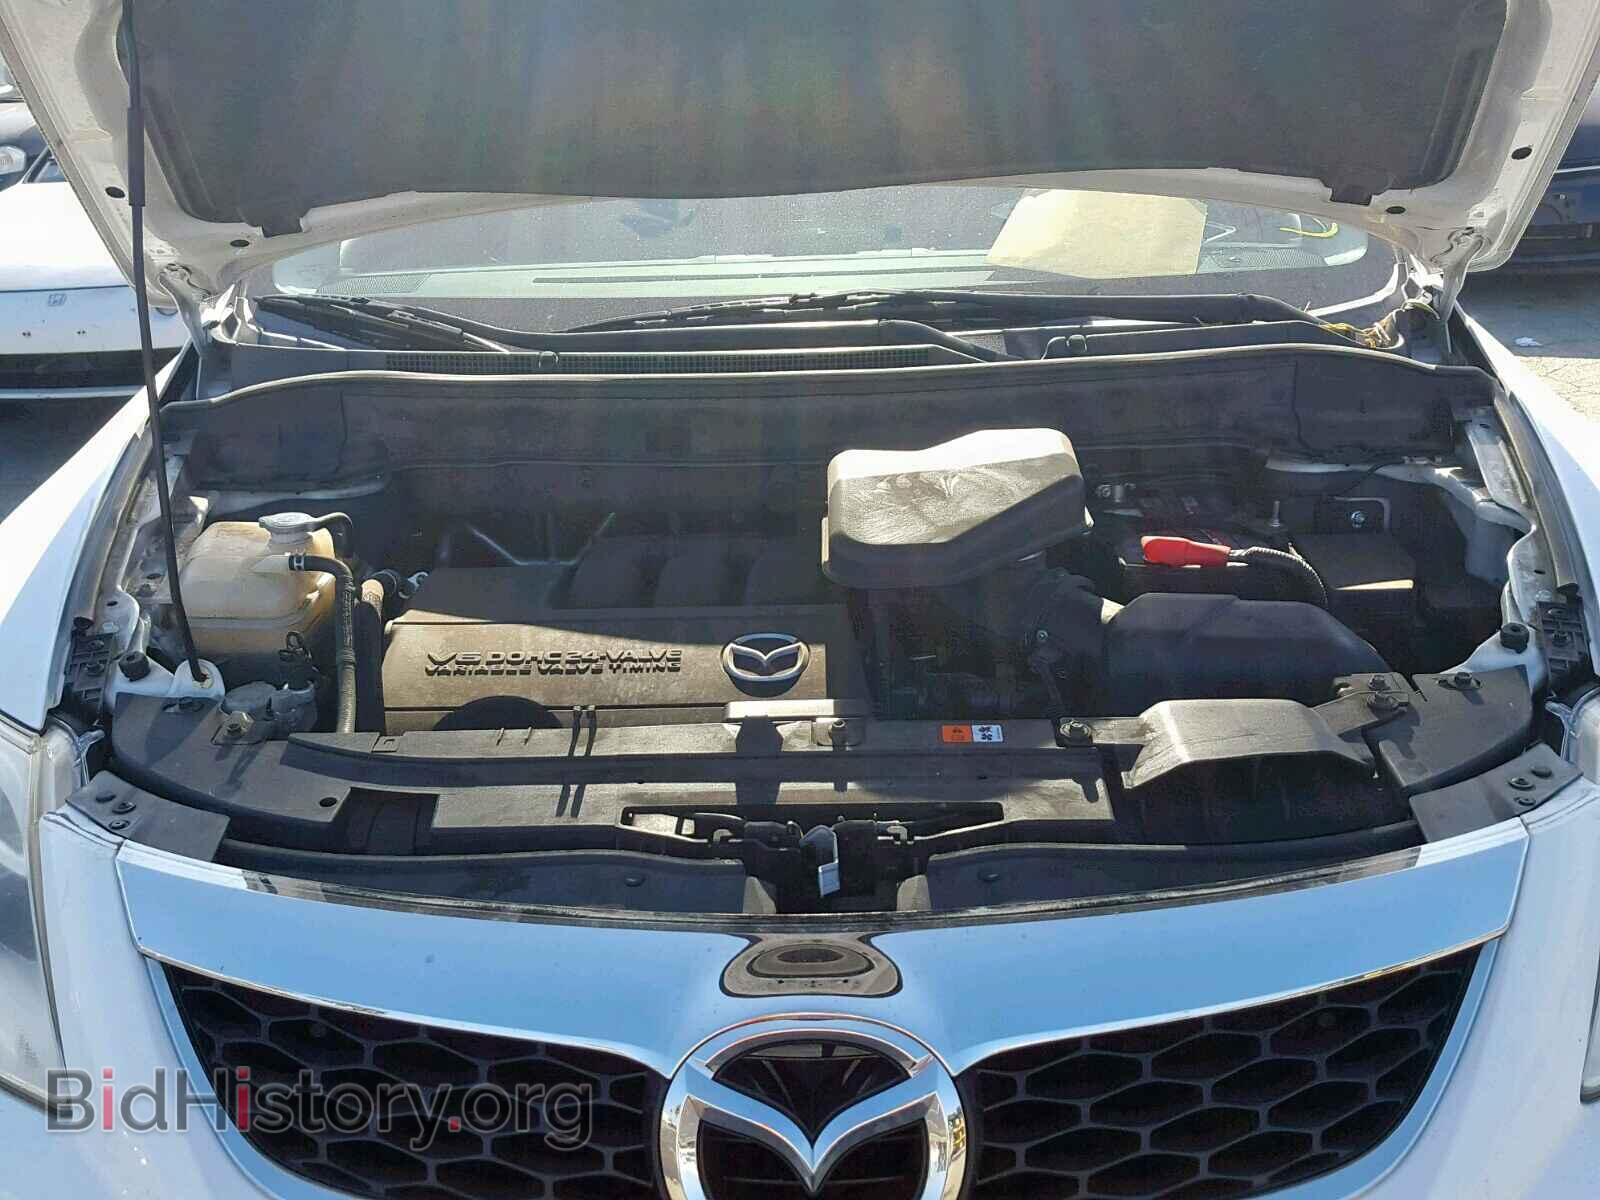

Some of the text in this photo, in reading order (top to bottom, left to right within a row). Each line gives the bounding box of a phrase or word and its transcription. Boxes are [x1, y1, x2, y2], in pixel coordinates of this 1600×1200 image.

[426, 648, 683, 665] V6 DOHC 24-VALVE
[424, 661, 682, 677] VARIABLE VALVE TIMING
